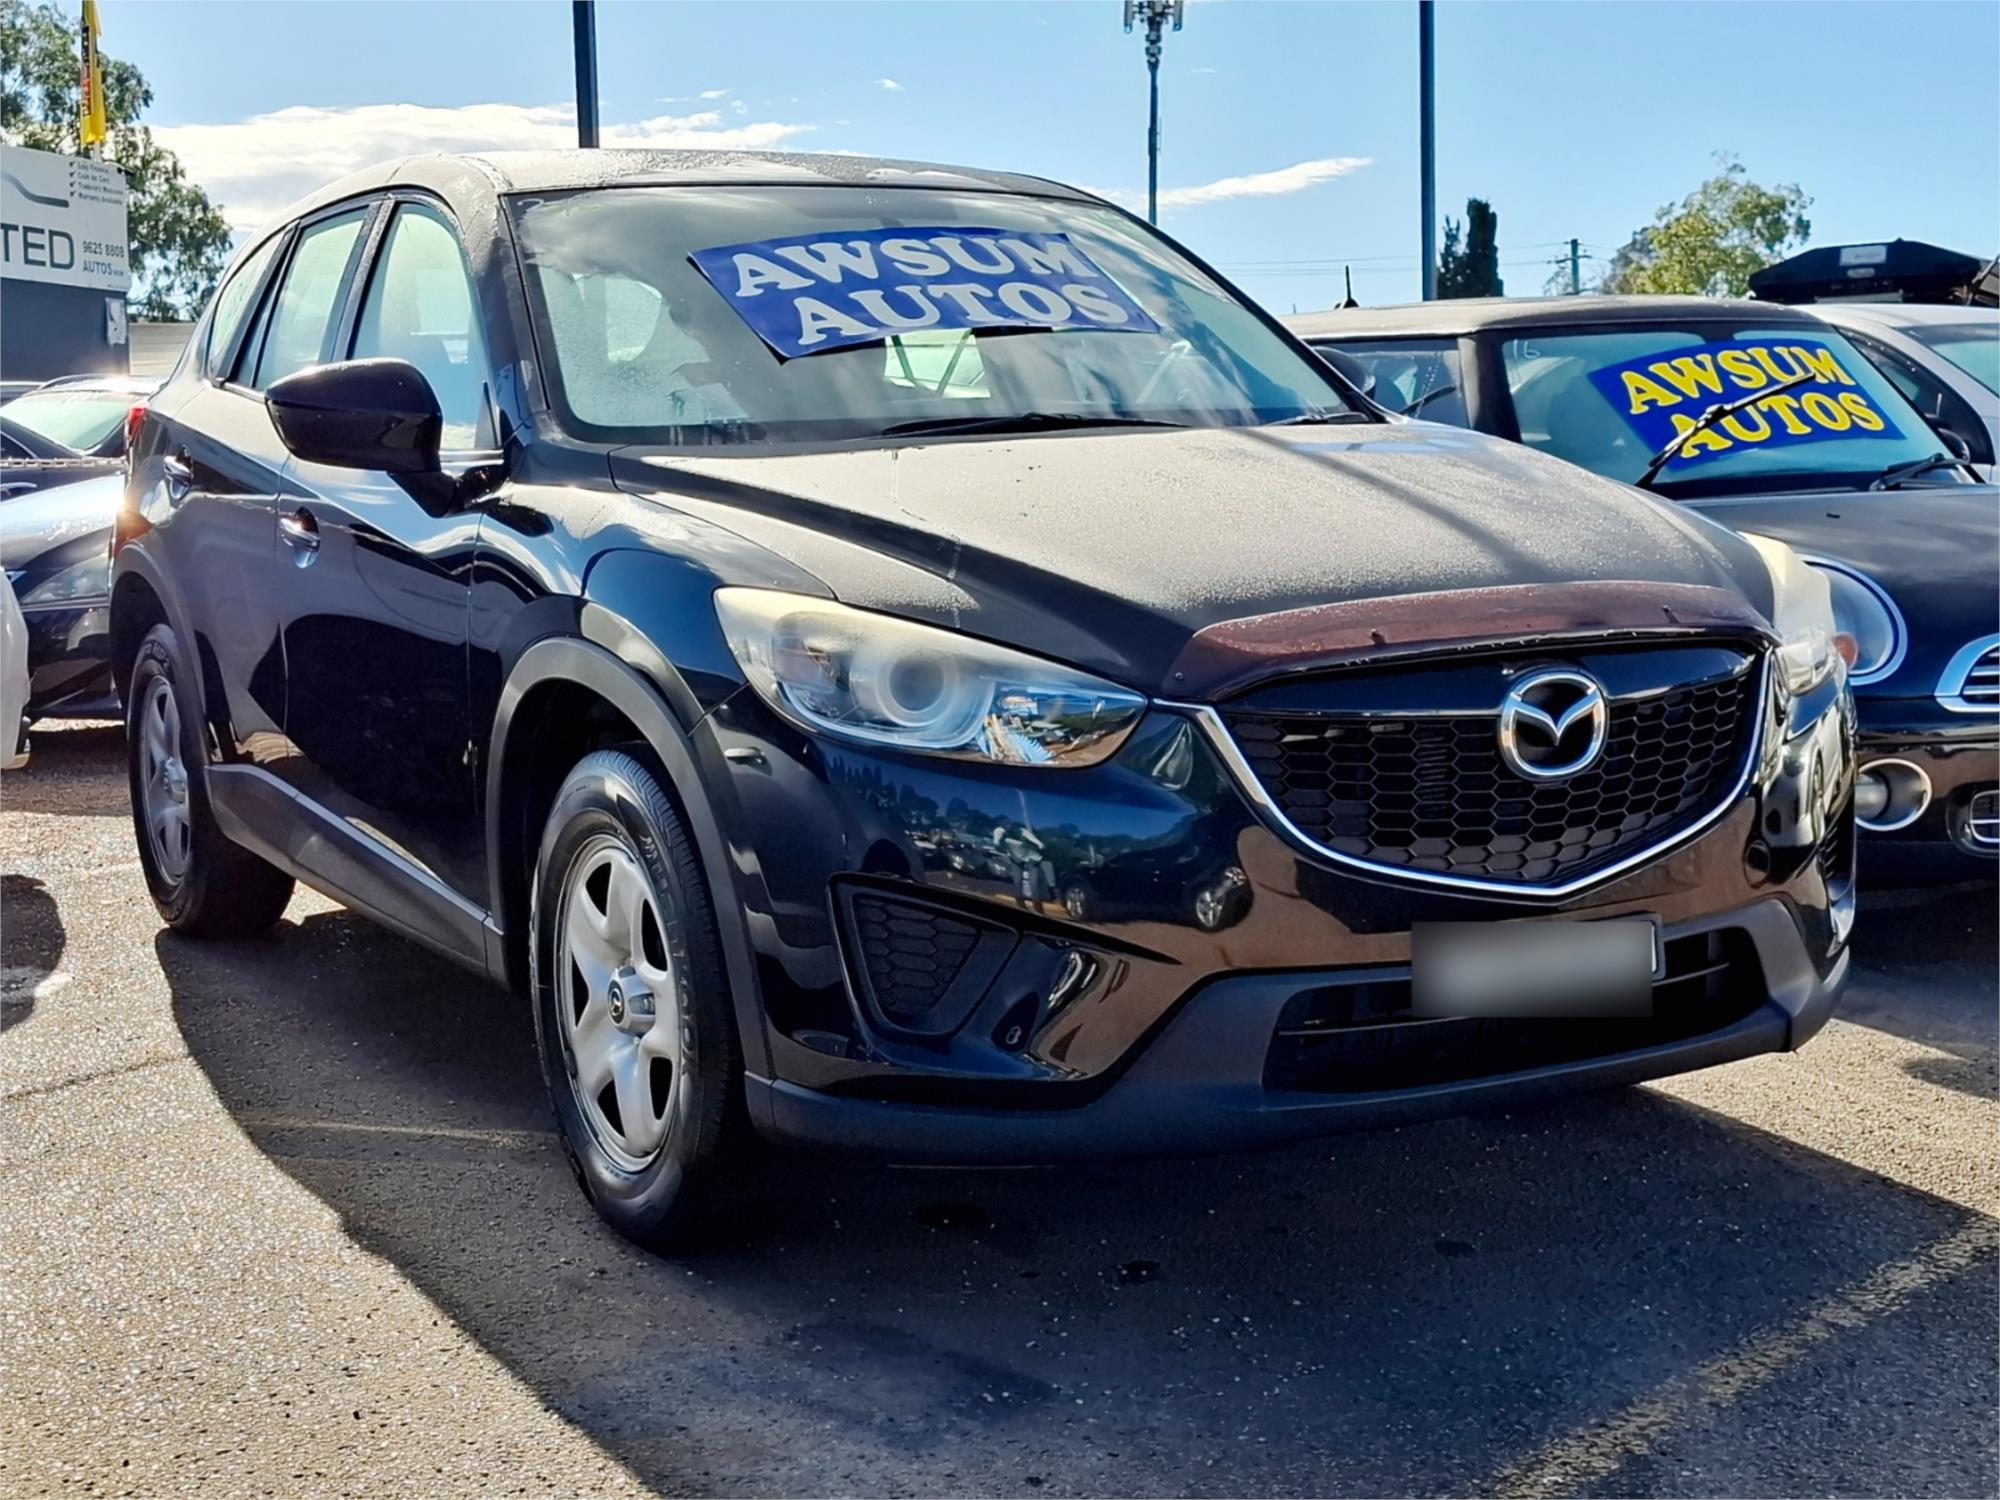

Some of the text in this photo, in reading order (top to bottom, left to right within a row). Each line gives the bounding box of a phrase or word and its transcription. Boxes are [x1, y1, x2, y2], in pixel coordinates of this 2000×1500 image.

[0, 222, 75, 270] TED
[82, 241, 103, 255] 9625
[82, 260, 113, 275] AUTOS
[732, 237, 1100, 297] AWSUM
[793, 282, 1130, 345] AUTOS
[1620, 347, 1856, 414] AWSUM
[1669, 392, 1885, 458] AUTOS
